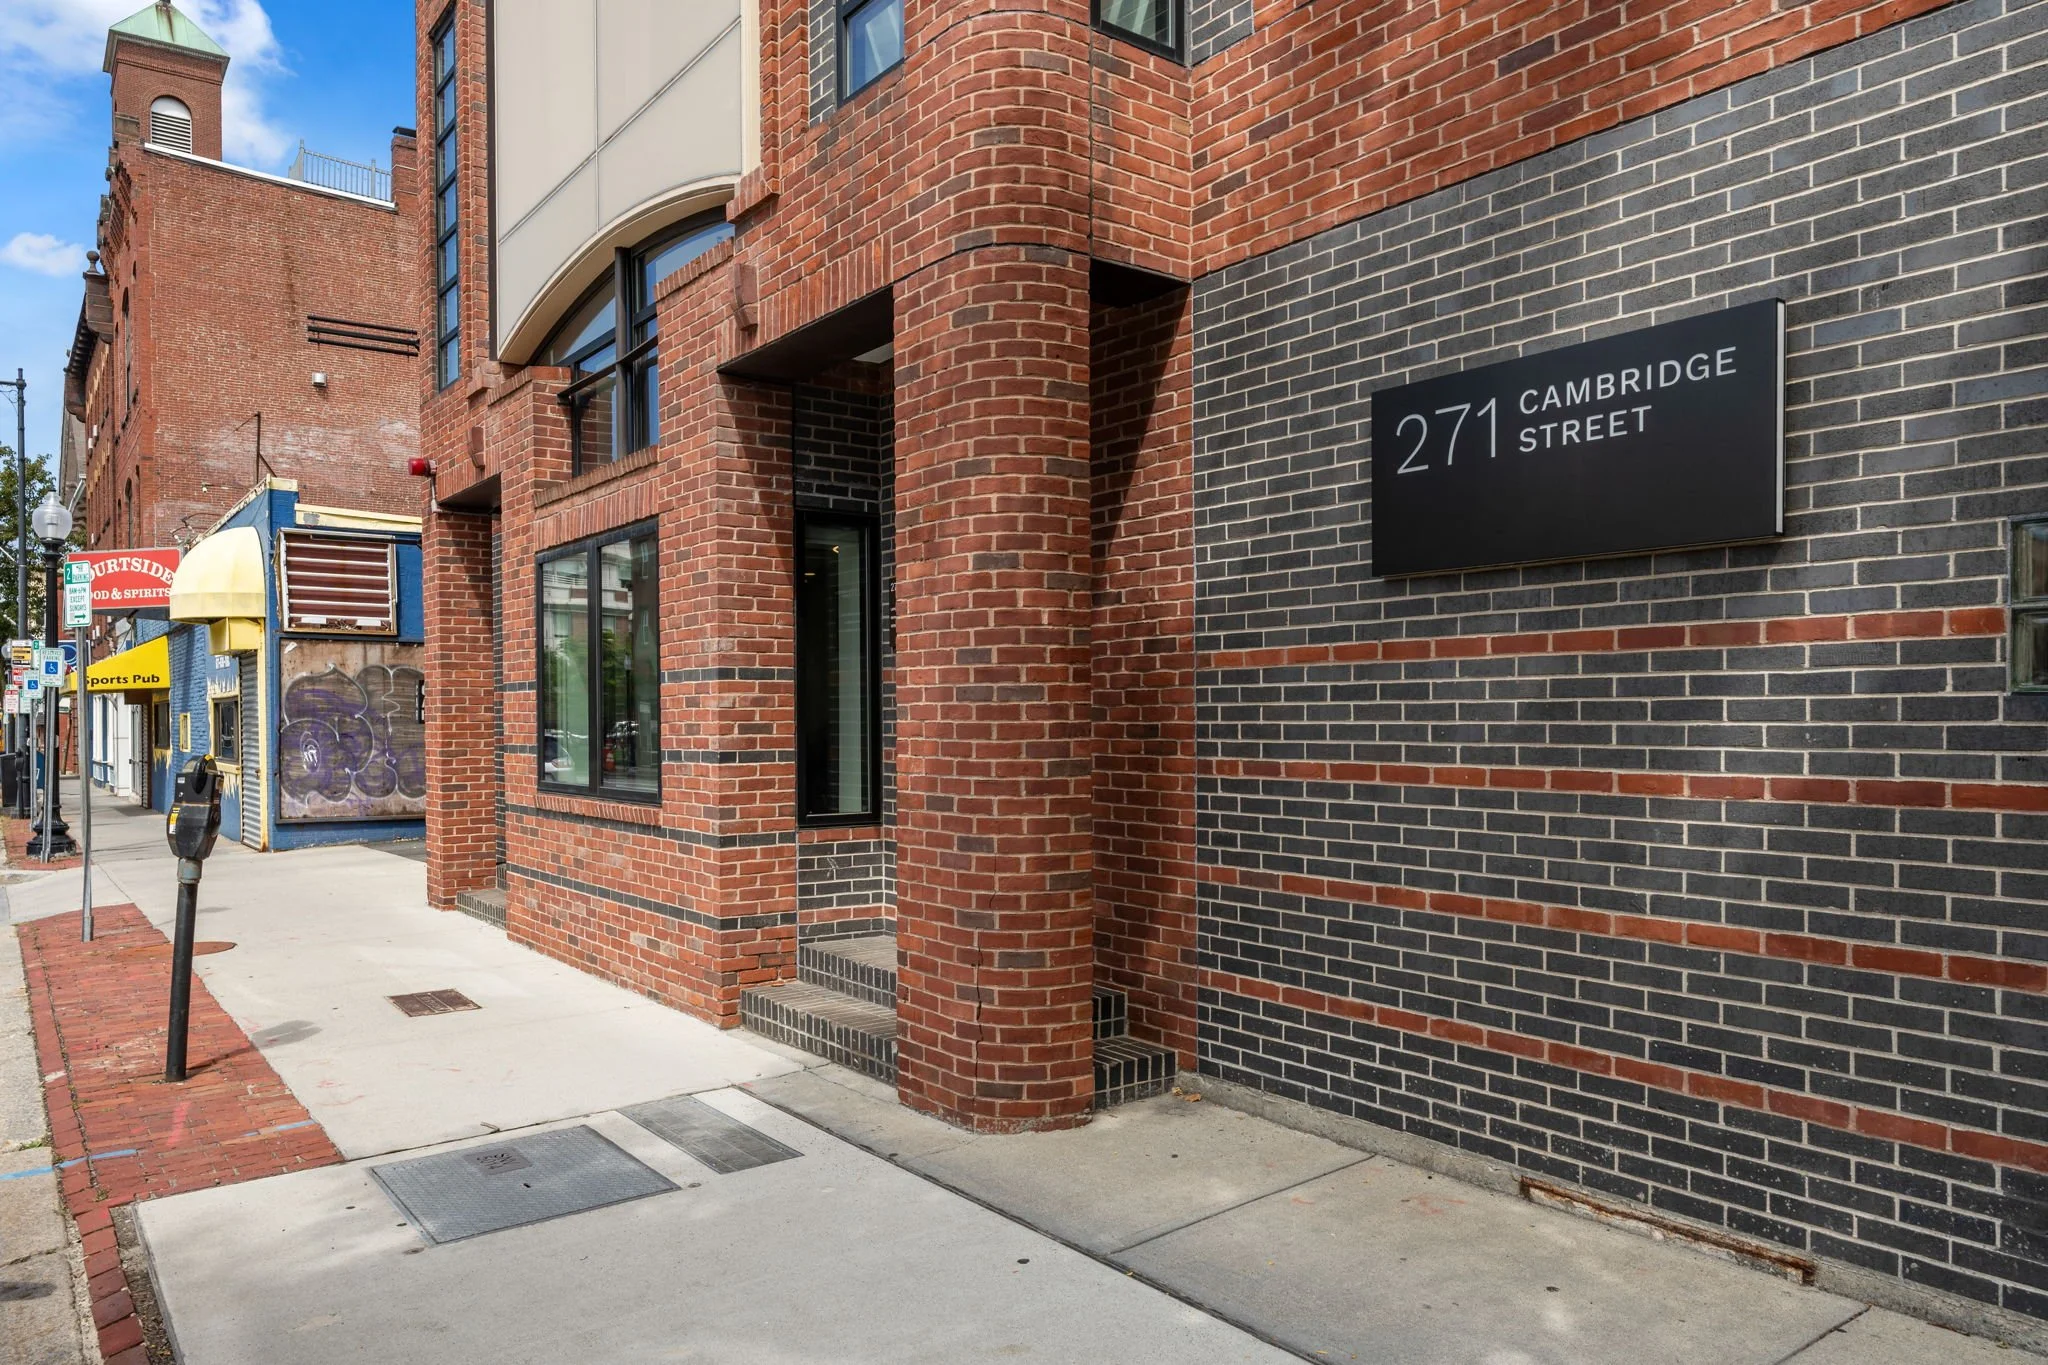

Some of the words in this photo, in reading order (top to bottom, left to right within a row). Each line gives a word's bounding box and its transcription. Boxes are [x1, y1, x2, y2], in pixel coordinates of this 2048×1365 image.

[1519, 346, 1737, 415] CAMBRIDGE
[1396, 397, 1497, 475] 271
[1519, 405, 1653, 453] STREET
[67, 567, 71, 581] 2
[111, 588, 122, 600] &
[124, 588, 172, 599] SPIRITS
[133, 674, 160, 684] Pub
